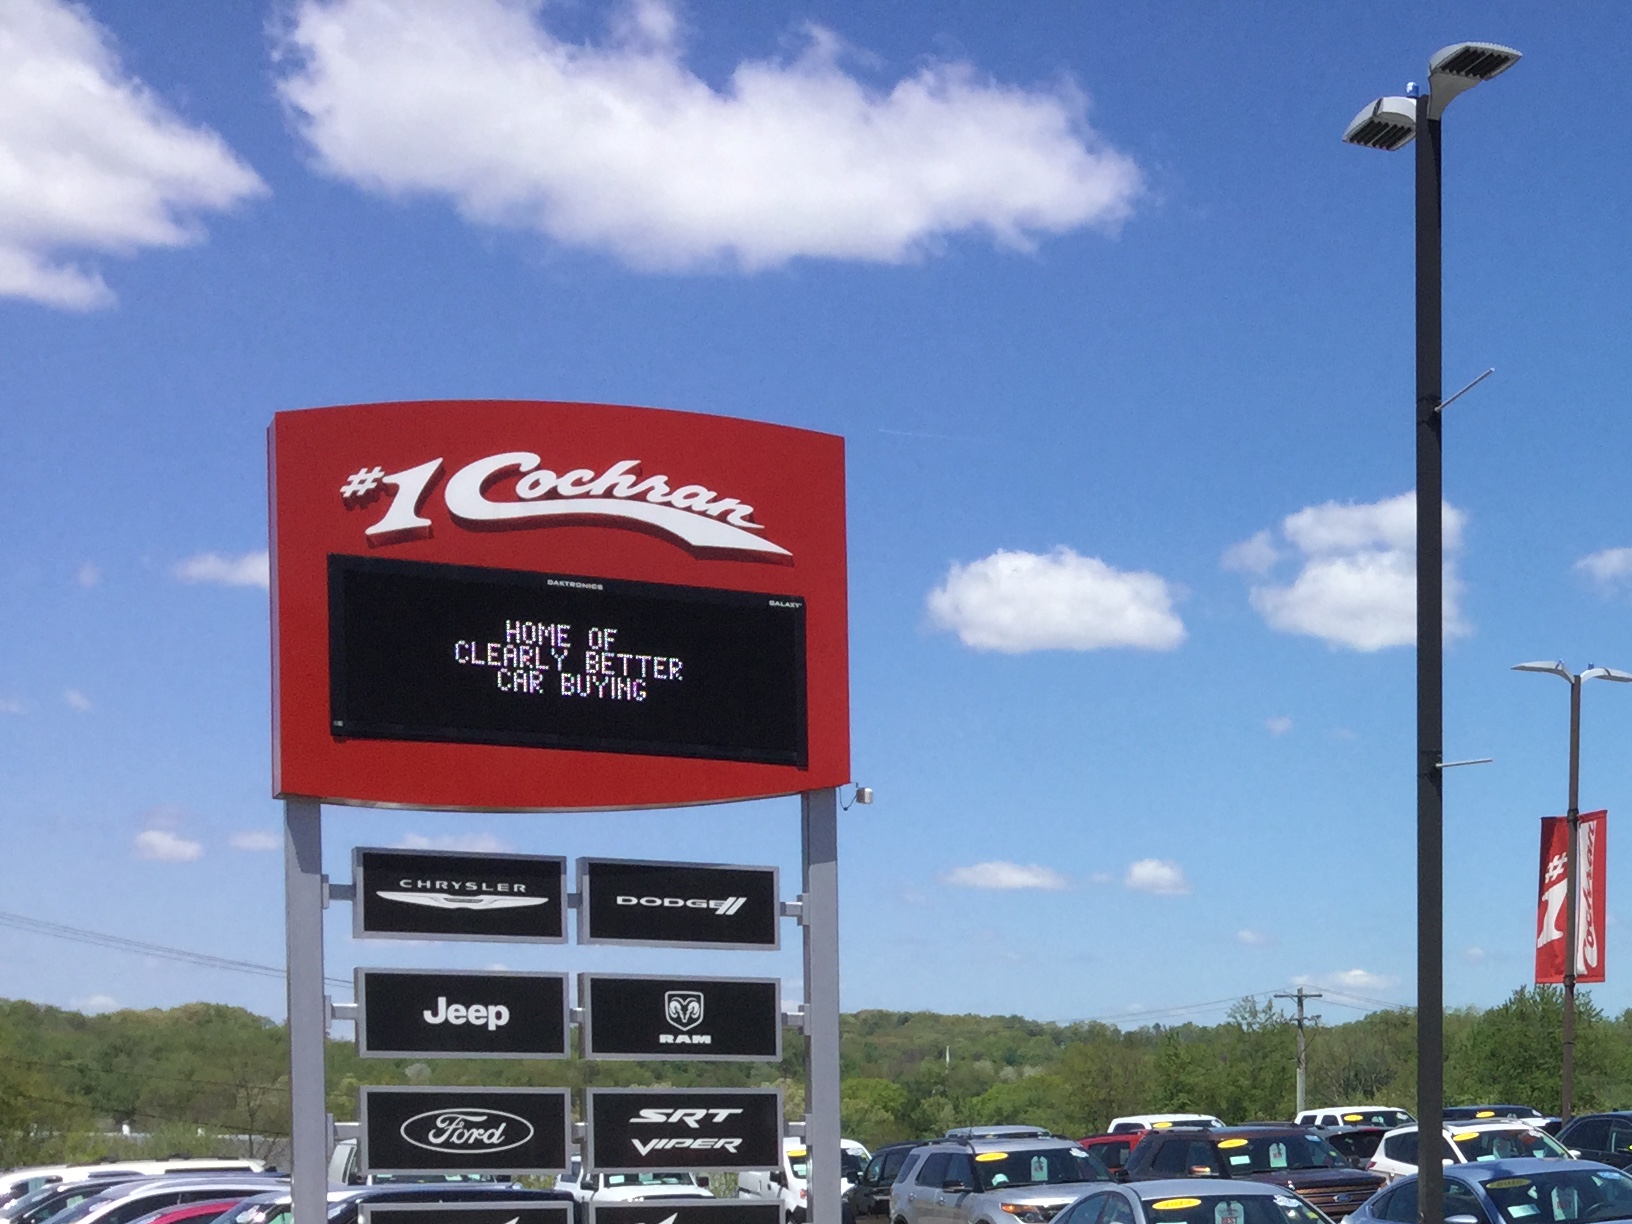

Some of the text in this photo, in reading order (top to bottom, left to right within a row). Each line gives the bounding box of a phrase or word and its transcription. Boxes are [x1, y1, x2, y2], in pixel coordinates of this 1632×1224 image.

[340, 451, 794, 556] #1 Cochran
[547, 579, 603, 590] DAKTRONICS
[768, 600, 802, 609] GALAXY
[506, 619, 618, 650] HOME OF
[455, 640, 684, 681] CLEARLY BETTER
[497, 668, 647, 701] CAR BUYING
[399, 879, 527, 893] CHRYSLER
[616, 895, 726, 910] DODGE
[423, 996, 510, 1031] Jeep
[659, 1033, 712, 1045] RAM
[428, 1113, 506, 1145] Ford
[629, 1108, 744, 1129] SRT
[631, 1138, 744, 1157] VIPER
